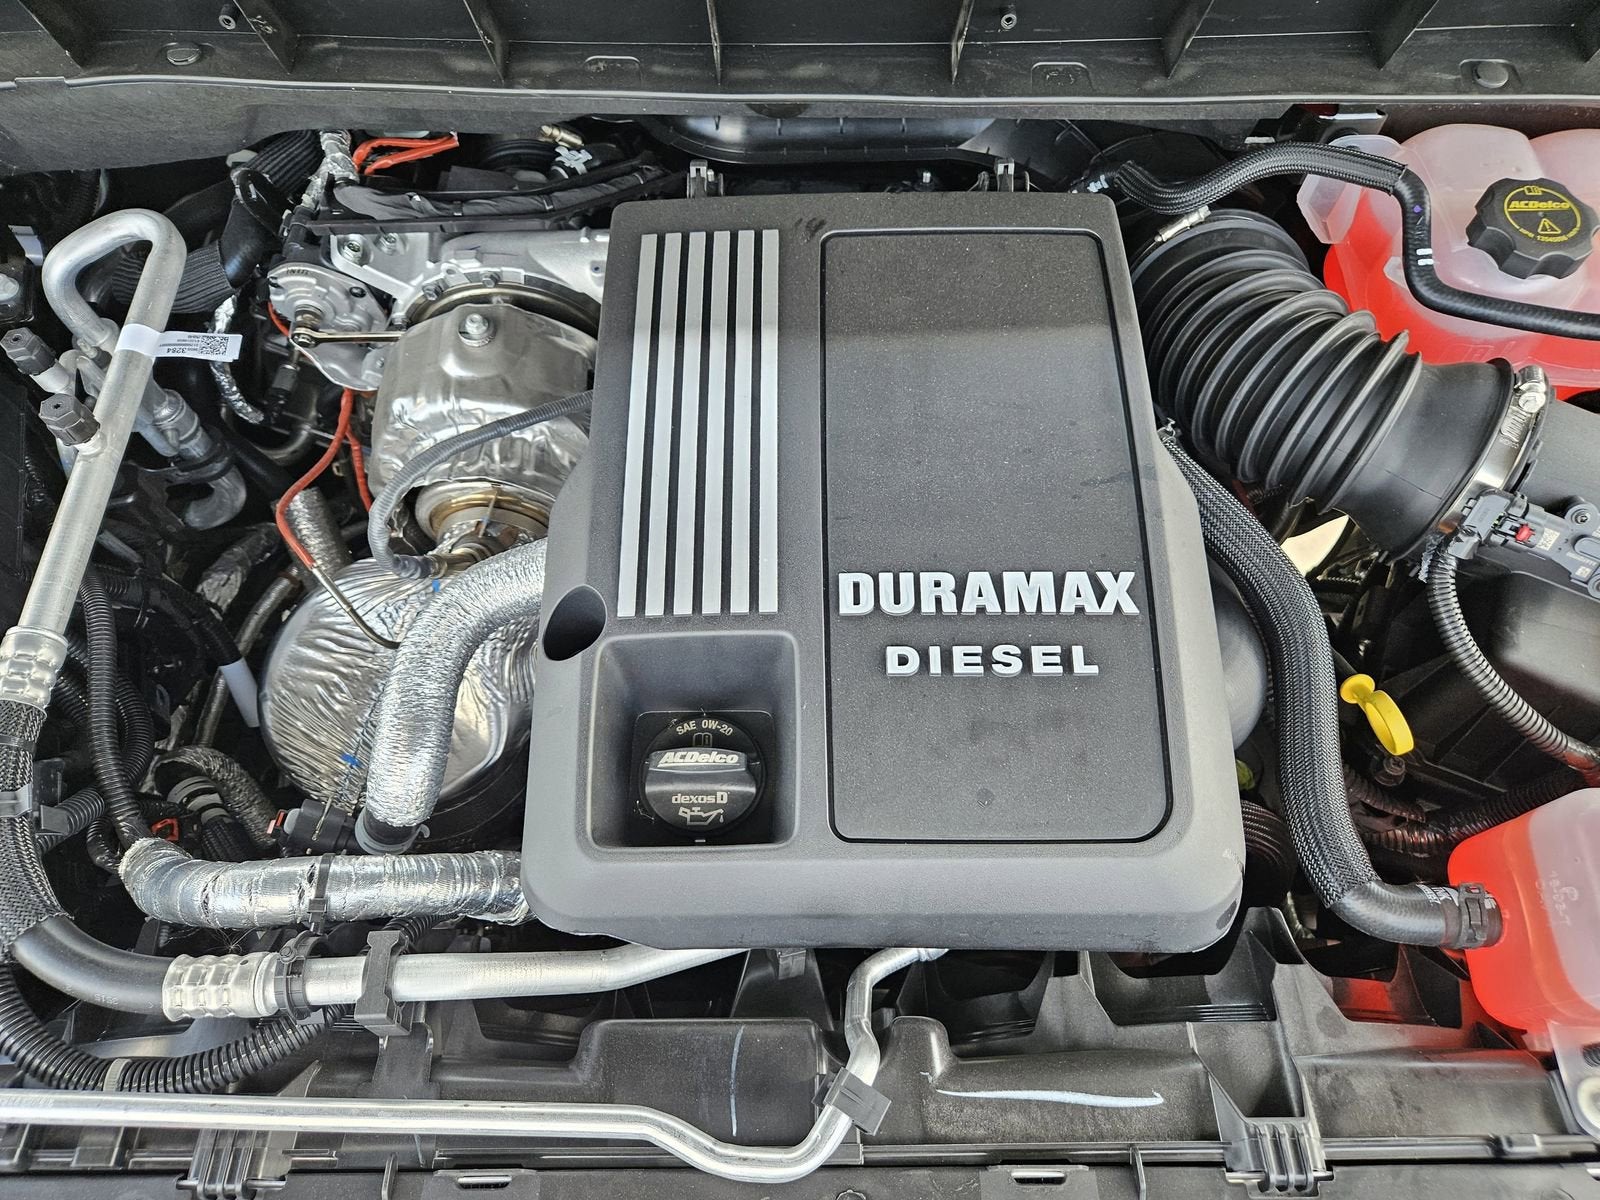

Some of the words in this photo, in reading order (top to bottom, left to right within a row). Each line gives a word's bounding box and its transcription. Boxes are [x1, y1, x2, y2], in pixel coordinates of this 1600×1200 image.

[1509, 200, 1570, 209] ACDelco
[838, 571, 1140, 616] DURAMAX
[886, 644, 1099, 677] DIESEL
[676, 720, 697, 736] SAE
[701, 719, 734, 736] 0W-20
[658, 751, 739, 764] ACDelco
